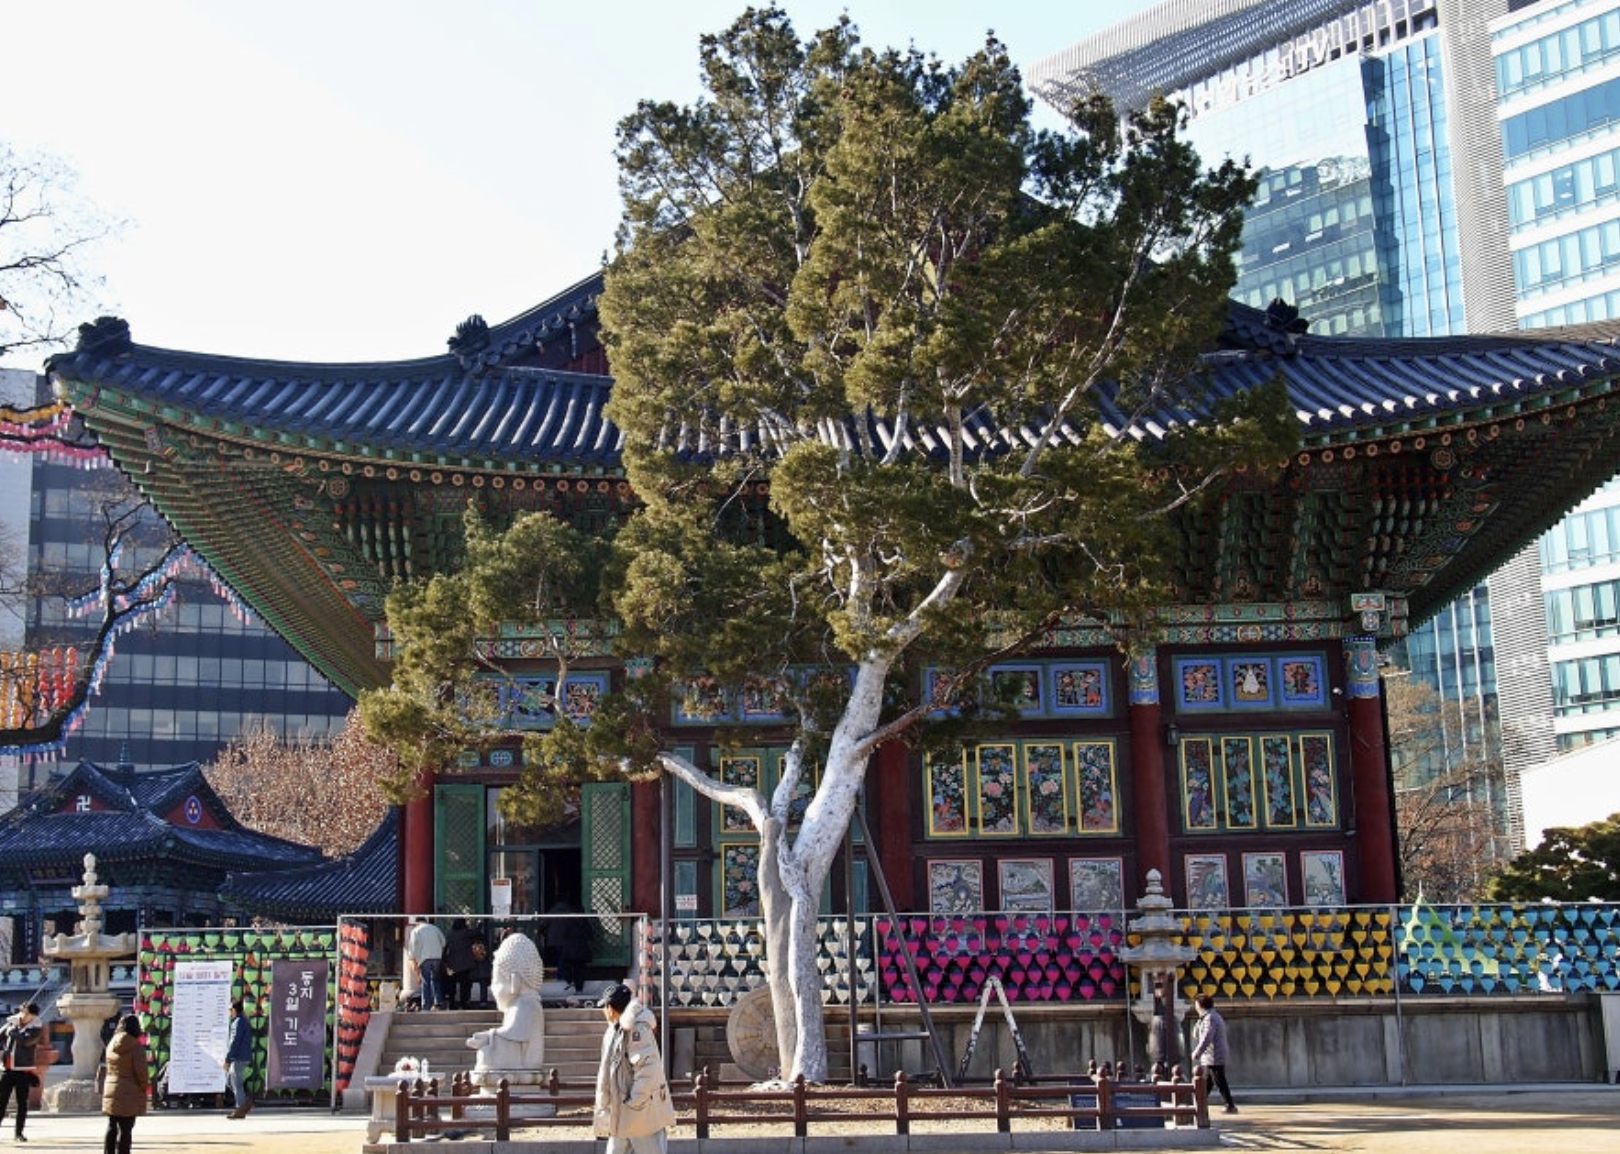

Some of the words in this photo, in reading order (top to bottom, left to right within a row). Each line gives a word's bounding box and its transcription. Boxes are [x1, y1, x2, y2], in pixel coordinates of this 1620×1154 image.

[285, 982, 300, 1012] 3일
[300, 971, 314, 1000] 동지
[283, 1016, 298, 1046] 기도
